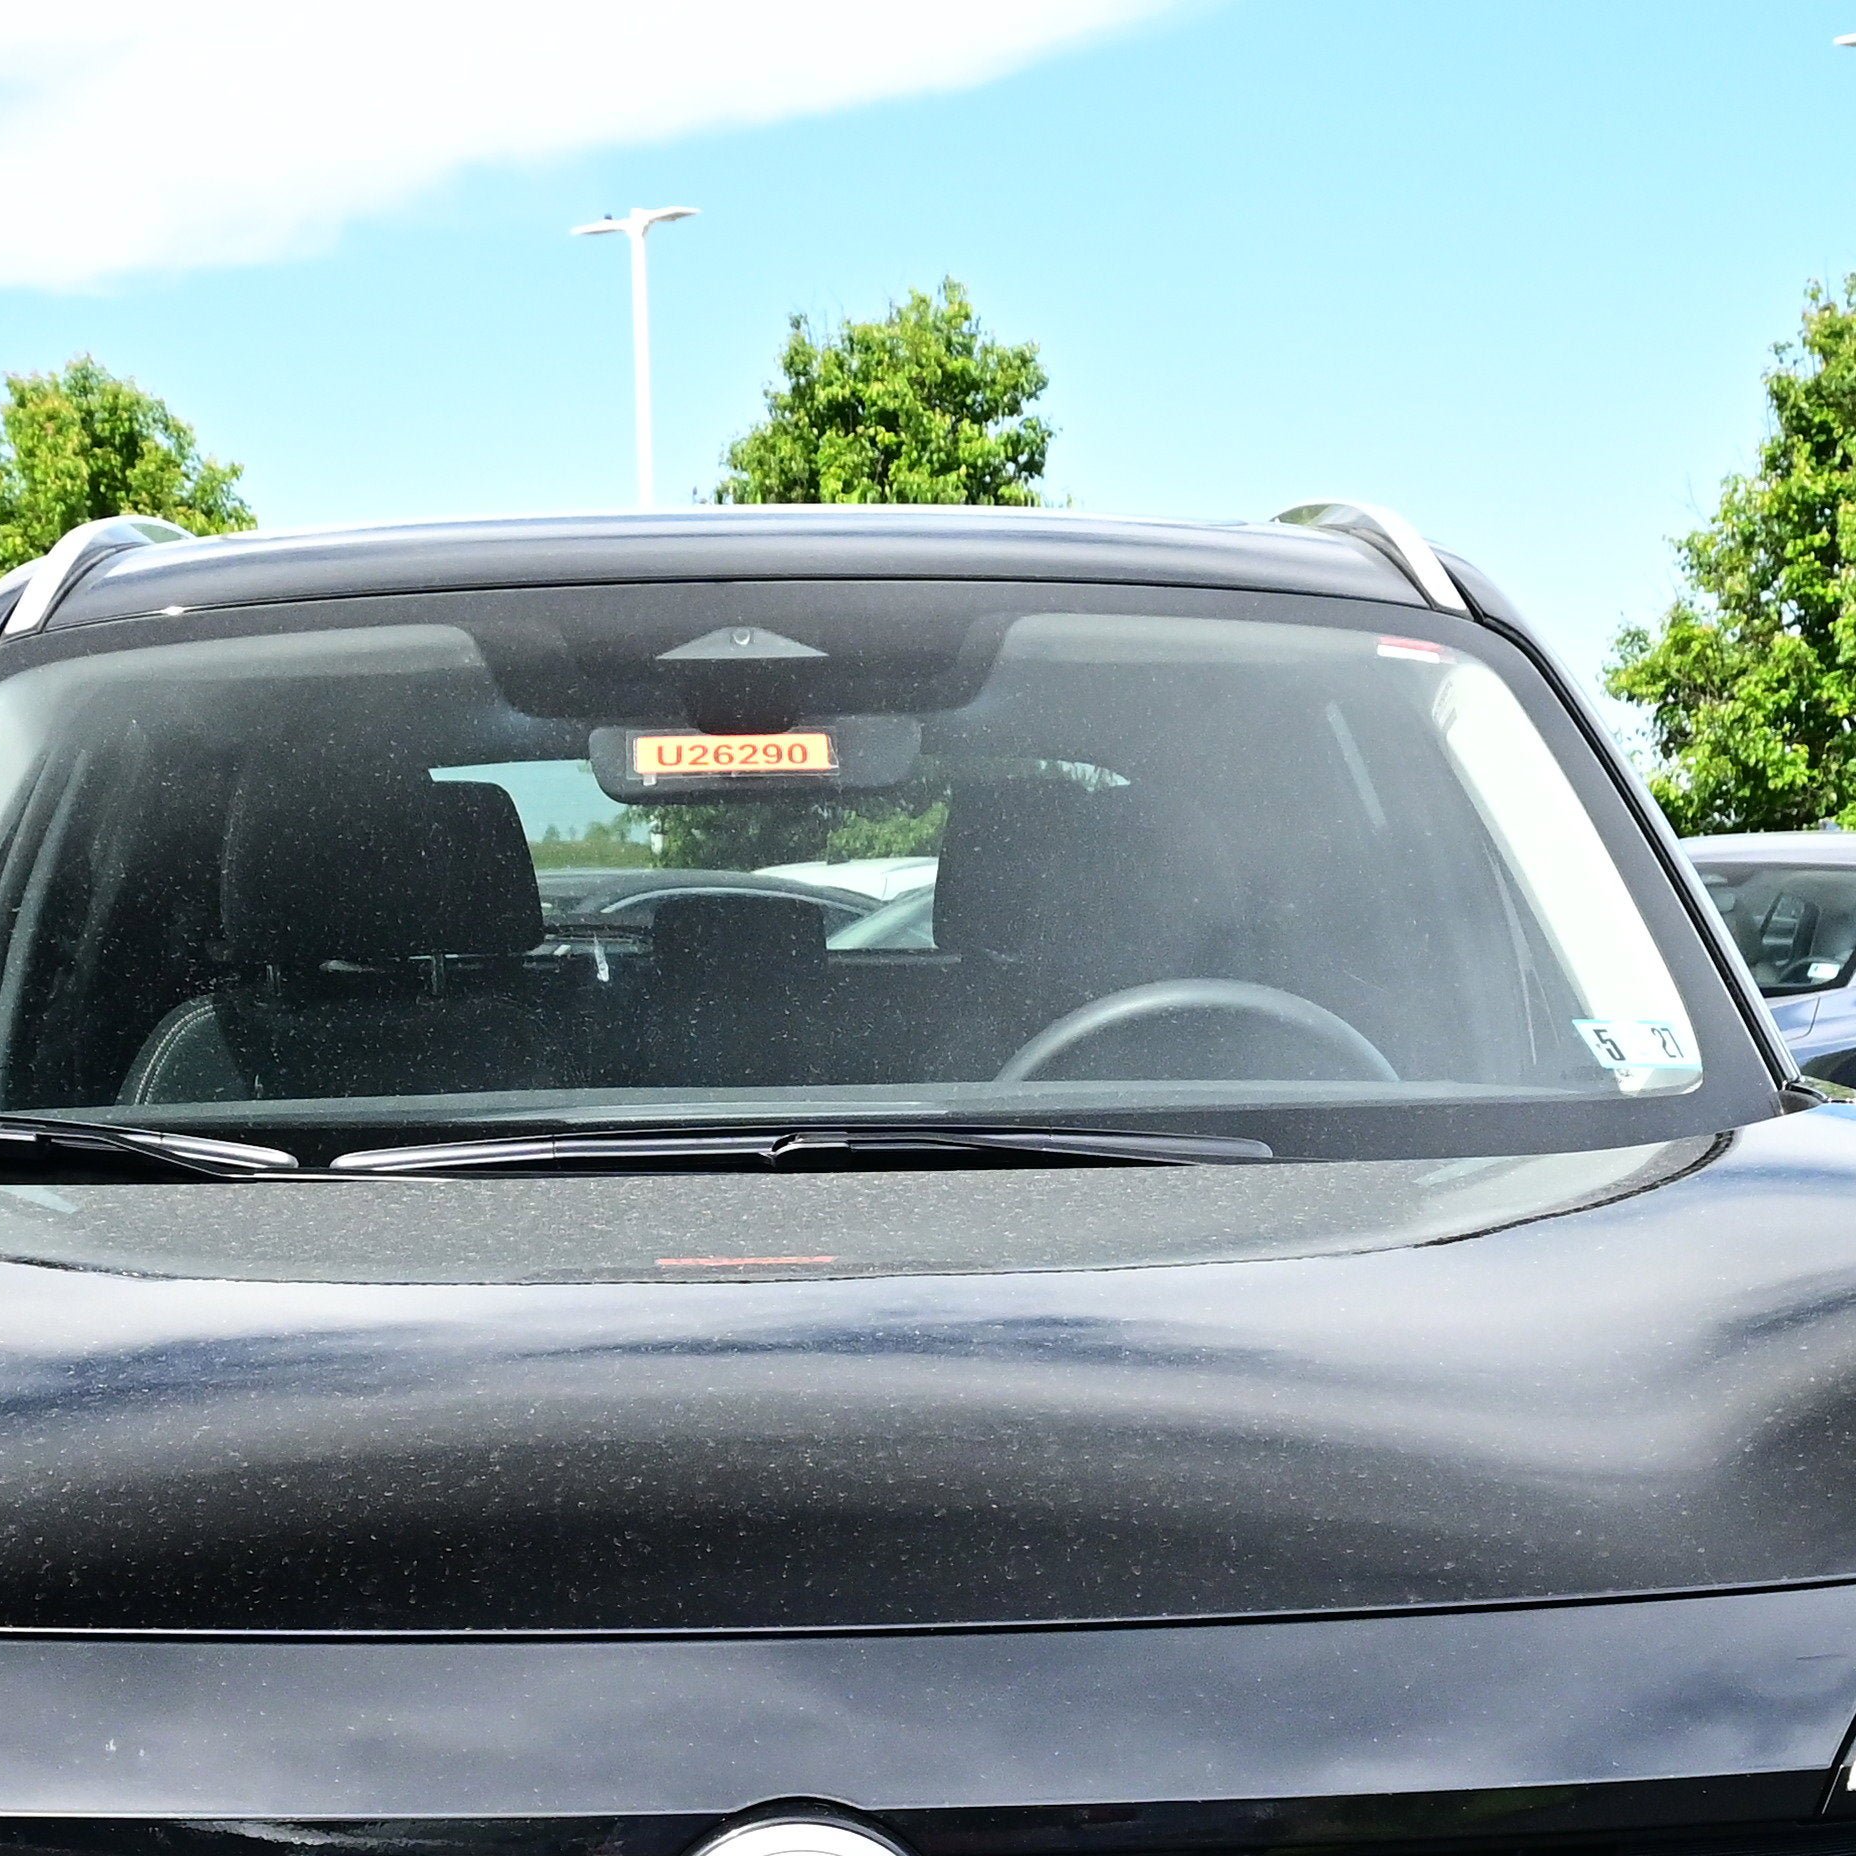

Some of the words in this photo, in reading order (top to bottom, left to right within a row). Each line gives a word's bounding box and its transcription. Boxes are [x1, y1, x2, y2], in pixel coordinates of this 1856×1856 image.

[656, 742, 808, 767] U26290
[1592, 1028, 1627, 1061] 5
[1650, 1026, 1685, 1059] 27
